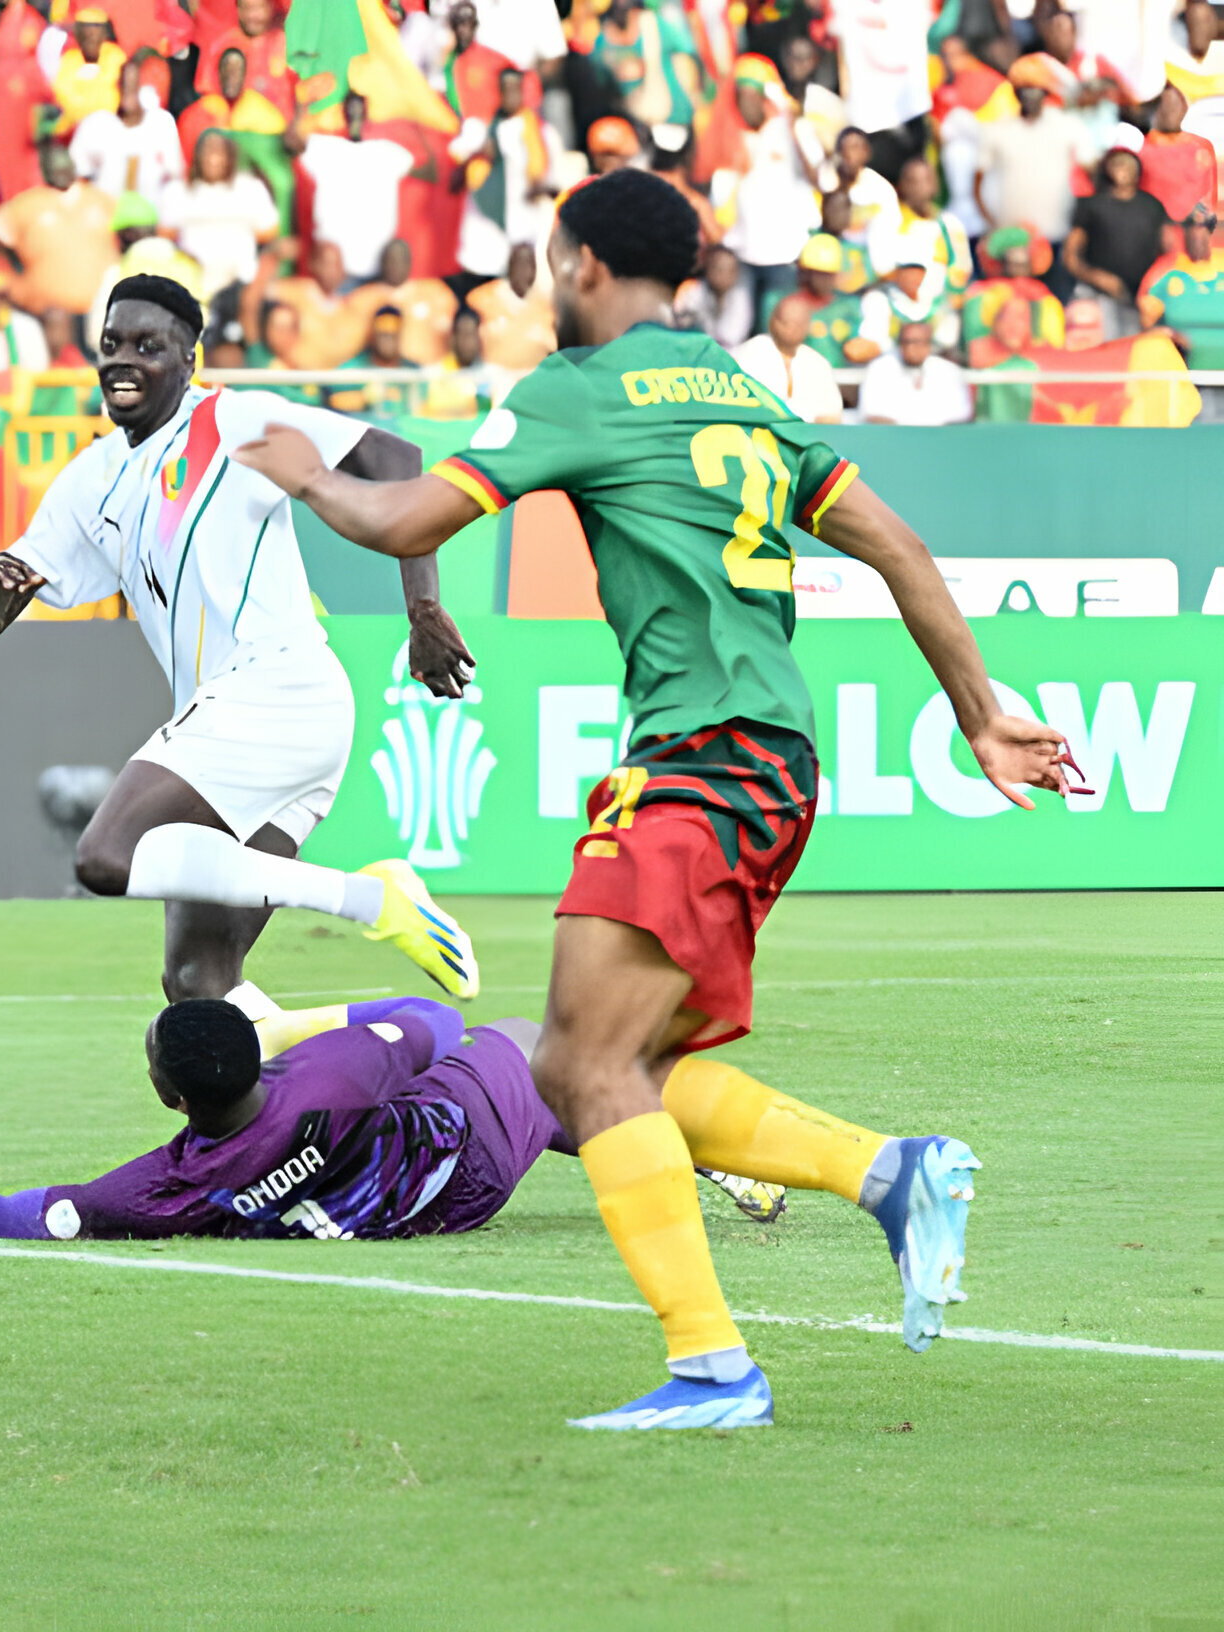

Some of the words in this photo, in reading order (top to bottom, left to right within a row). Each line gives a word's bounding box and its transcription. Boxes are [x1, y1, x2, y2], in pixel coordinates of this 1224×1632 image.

[690, 423, 792, 592] 21
[944, 576, 1121, 617] AF
[538, 678, 1196, 819] FLOW
